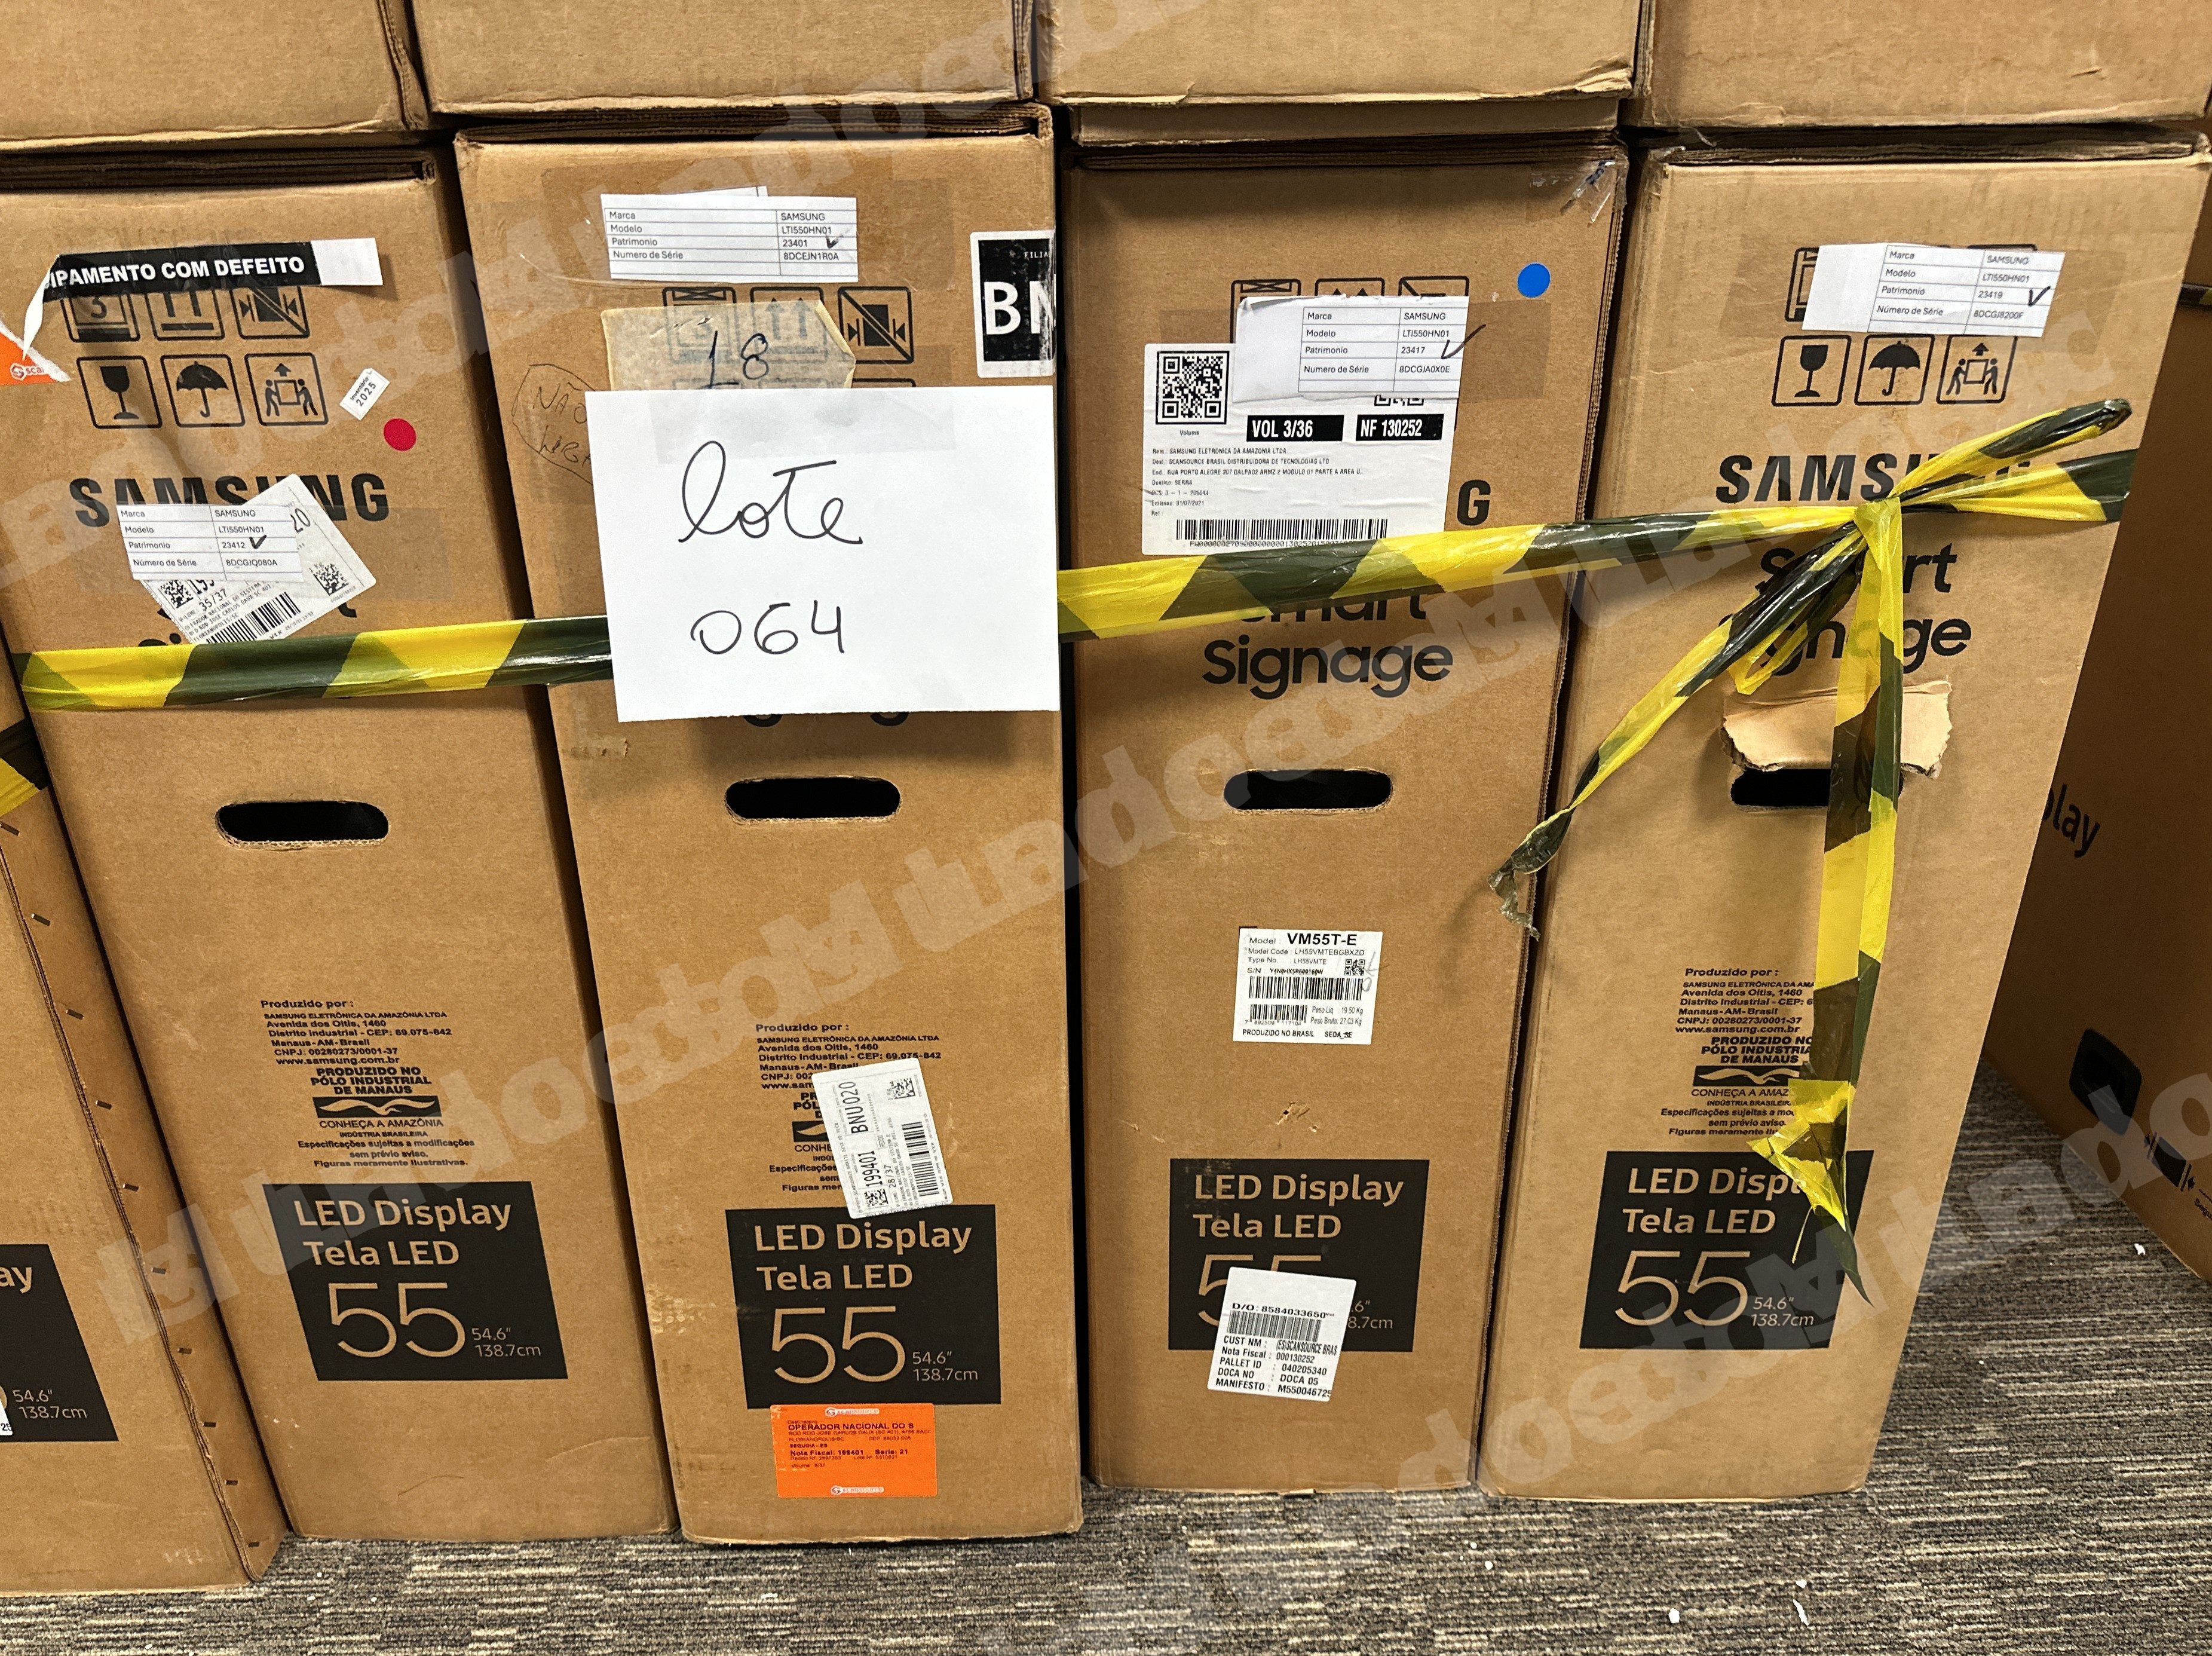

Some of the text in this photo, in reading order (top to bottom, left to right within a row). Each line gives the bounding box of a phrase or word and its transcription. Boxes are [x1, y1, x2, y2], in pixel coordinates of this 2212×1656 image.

[781, 212, 825, 221] SAMSUNG
[611, 225, 642, 233] Modelo
[783, 239, 807, 247] 23401
[662, 251, 683, 259] Série
[1889, 251, 2029, 265] Marca SAMSUNG
[162, 261, 210, 280] COM
[217, 257, 305, 276] DEFEITO
[1885, 269, 1916, 278] Modelo
[1881, 286, 2003, 299] Patrimonio 23419
[1877, 305, 1910, 315] Número
[1911, 307, 1921, 315] de
[1923, 306, 1943, 316] Série
[1306, 329, 1336, 338] Modelo
[1304, 365, 1335, 374] Numero
[1349, 365, 1369, 374] Série
[356, 382, 376, 406] 2025
[1252, 420, 1313, 437] VOL 3/36
[1361, 419, 1423, 437] NF 130252
[128, 541, 171, 549] Patrimonio
[133, 558, 168, 567] Número
[198, 587, 229, 612] 35/37
[690, 599, 845, 656] 064
[1202, 634, 1454, 700] Signage
[1287, 933, 1357, 945] VM55T-E
[1685, 968, 1747, 977] Produzido
[261, 1000, 347, 1009] Produzido por
[822, 1024, 842, 1033] por
[1711, 1036, 1792, 1045] PRODUZIDO
[1702, 1043, 1737, 1054] PÓLO
[316, 1067, 397, 1076] PRODUZIDO
[311, 1075, 347, 1085] PÓLO
[838, 1081, 869, 1134] BNU020
[320, 1120, 374, 1129] CONHEÇA
[387, 1119, 443, 1127] AMAZÔNIA
[857, 1150, 883, 1188] 199401
[1628, 1167, 1699, 1194] LED
[1196, 1174, 1404, 1207] LED Display
[293, 1198, 511, 1232] LED Display
[1622, 1208, 1776, 1233] Tela LED
[1193, 1213, 1341, 1238] Tela LED
[754, 1220, 972, 1255] LED Display
[303, 1239, 460, 1266] Tela LED
[756, 1264, 913, 1291] Tela LED
[1614, 1250, 1751, 1327] 55
[1753, 1296, 1794, 1311] 54.6"
[328, 1282, 465, 1358] 55
[1751, 1314, 1813, 1327] 138.7cm
[471, 1327, 511, 1340] 54.6"
[474, 1344, 541, 1357] 138.7cm
[771, 1306, 905, 1384] 55
[1224, 1335, 1245, 1345] CUST
[1249, 1339, 1262, 1347] NM
[1323, 1345, 1337, 1355] BRAS
[912, 1351, 952, 1364] 54.6"
[1221, 1346, 1240, 1357] Nota
[1243, 1349, 1266, 1359] Fiscal
[1220, 1357, 1250, 1367] PALLET
[1253, 1359, 1261, 1369] ID
[913, 1368, 978, 1381] 138.7cm
[1218, 1368, 1319, 1385] DOCA NO DOCA 05
[1215, 1378, 1265, 1391] MANIFESTO
[13, 1389, 53, 1403] 54.6"
[19, 1406, 87, 1419] 138.7cm
